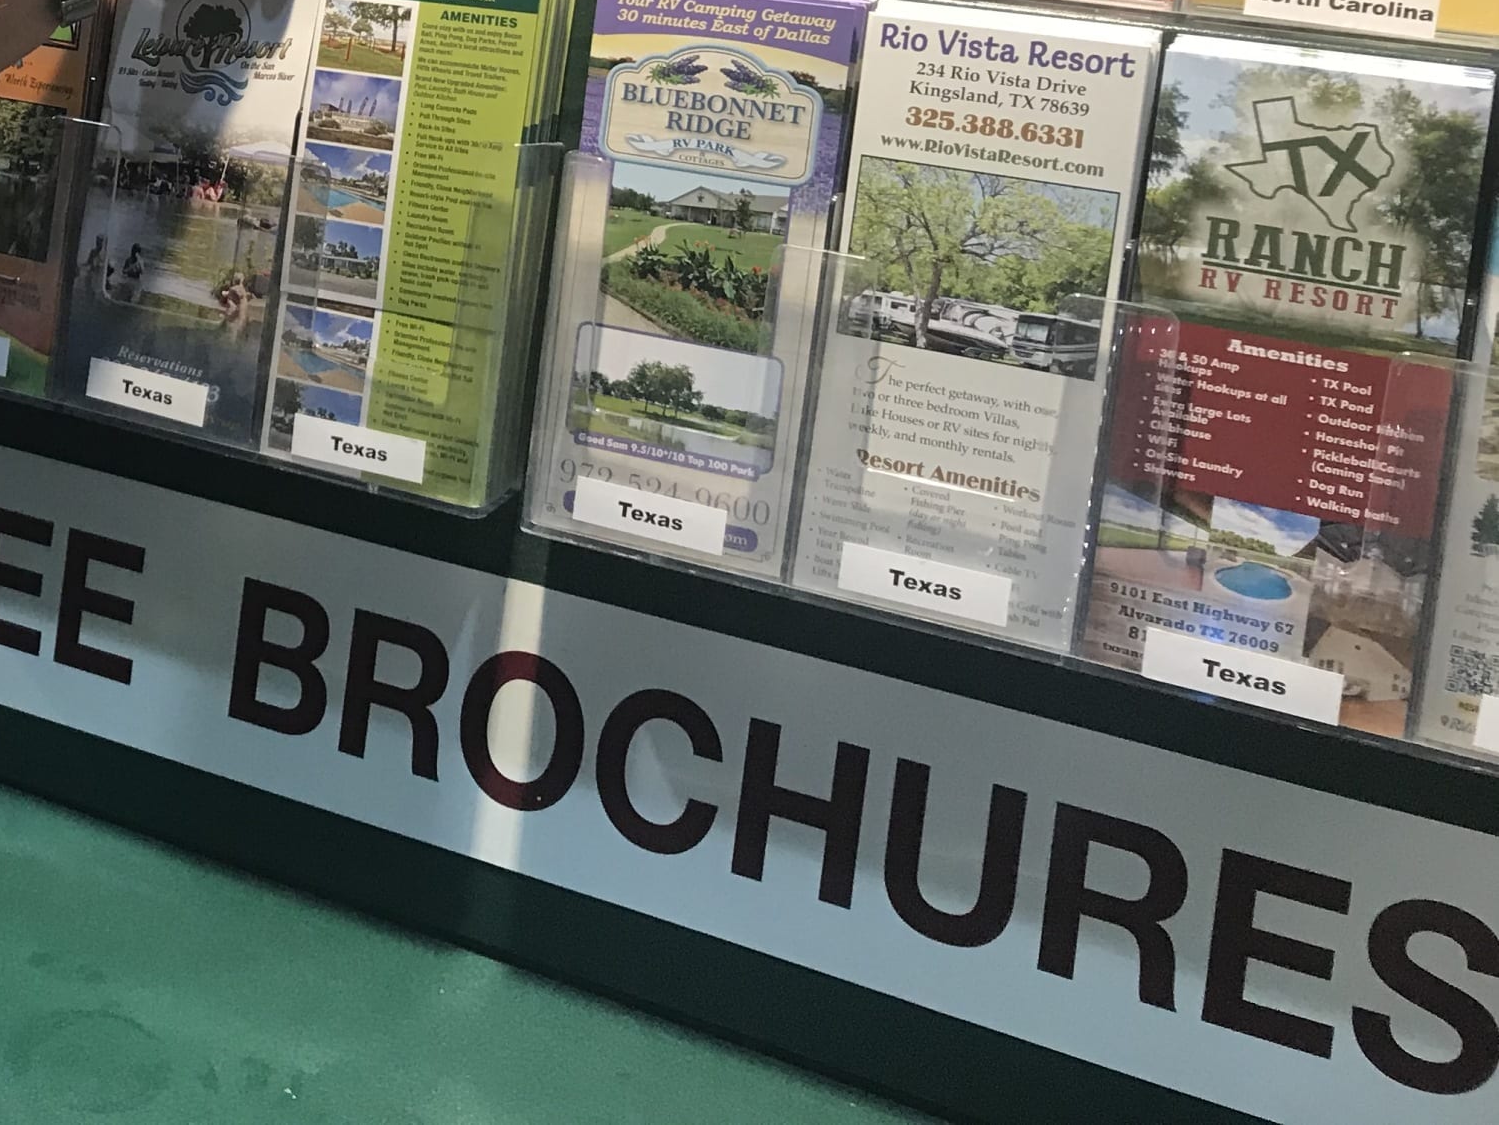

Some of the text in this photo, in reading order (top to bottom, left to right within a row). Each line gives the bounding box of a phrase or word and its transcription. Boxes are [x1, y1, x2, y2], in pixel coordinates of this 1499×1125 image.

[440, 11, 518, 28] AMENITIES
[617, 9, 830, 45] 30 minutes East of Dallas
[684, 1, 757, 22] Camping
[761, 9, 836, 30] Getaway
[880, 23, 1135, 78] Rio Vista Resort
[917, 62, 1086, 96] 234 Rio Vista Drive
[621, 82, 805, 125] BLUEBONNET
[909, 80, 1090, 116] Kingsland, TX 78639
[665, 110, 751, 140] RIDGE
[905, 107, 1084, 149] 325.388.6331
[673, 138, 735, 155] RV PARK
[881, 135, 1104, 177] www.RioVistaResort.com
[1201, 216, 1406, 290] RANCH
[1198, 267, 1398, 320] RV RESORT
[1227, 339, 1349, 373] Amenities
[122, 379, 173, 405] Texas
[331, 435, 387, 462] Texas
[618, 501, 683, 531] Texas
[889, 568, 962, 601] Texas
[1110, 582, 1294, 635] 9101 East Highway 67
[1117, 604, 1279, 653] Alvarado TX 76009
[1202, 658, 1286, 696] Texas
[226, 576, 1499, 1097] BROCHURES
